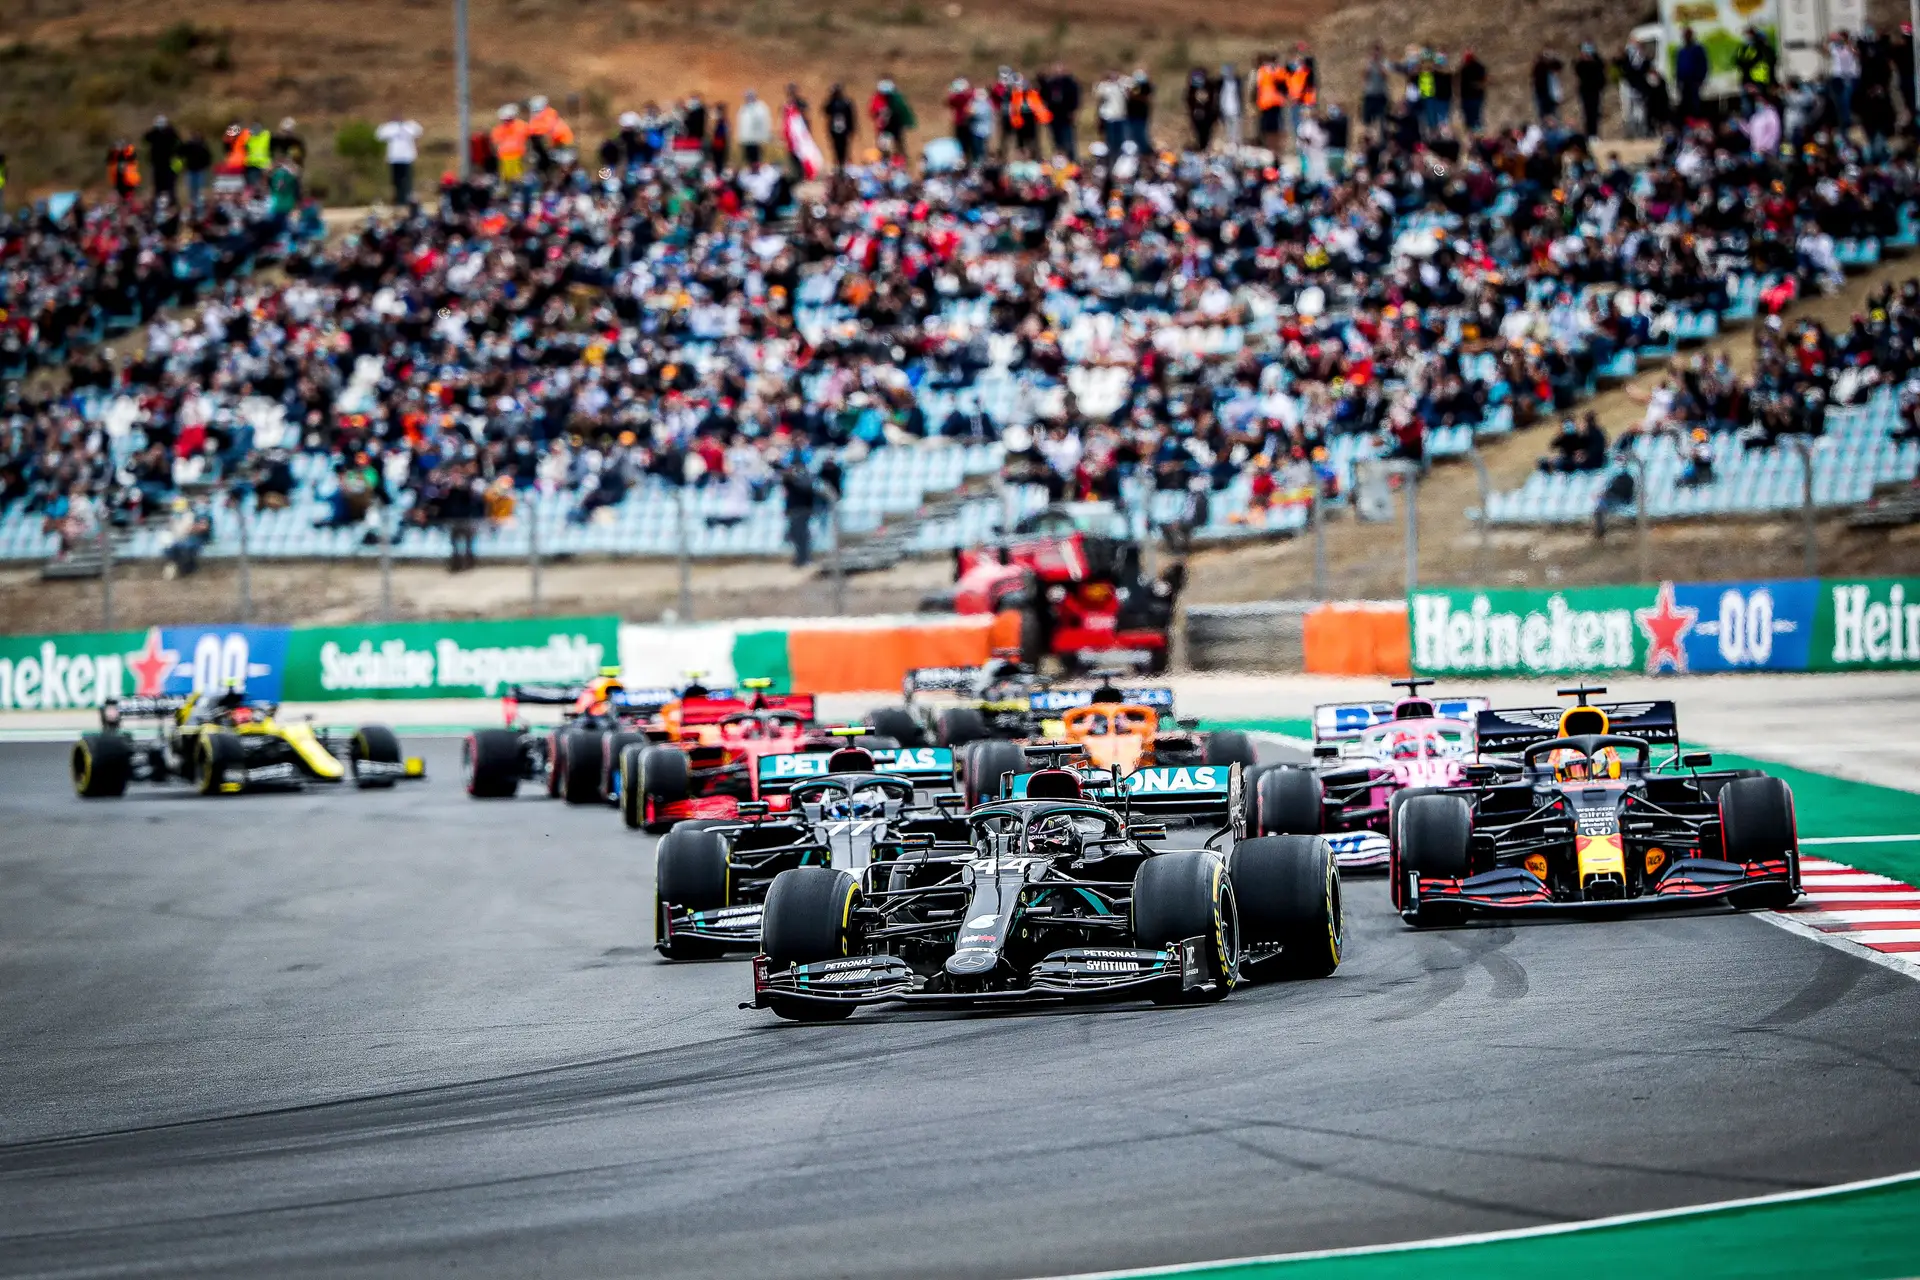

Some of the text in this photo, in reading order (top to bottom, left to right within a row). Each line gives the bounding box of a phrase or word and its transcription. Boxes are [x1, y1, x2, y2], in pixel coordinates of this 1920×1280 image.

[1412, 592, 1634, 670] Heineken
[775, 748, 936, 776] PETNAS
[828, 821, 874, 836] 77
[972, 857, 1031, 875] 44
[717, 904, 763, 917] PETRONAS
[1083, 950, 1138, 959] PETRONAS
[824, 958, 873, 970] PETRONAS
[1086, 960, 1140, 972] SYNTIUM
[820, 968, 872, 982] SYNTIUM
